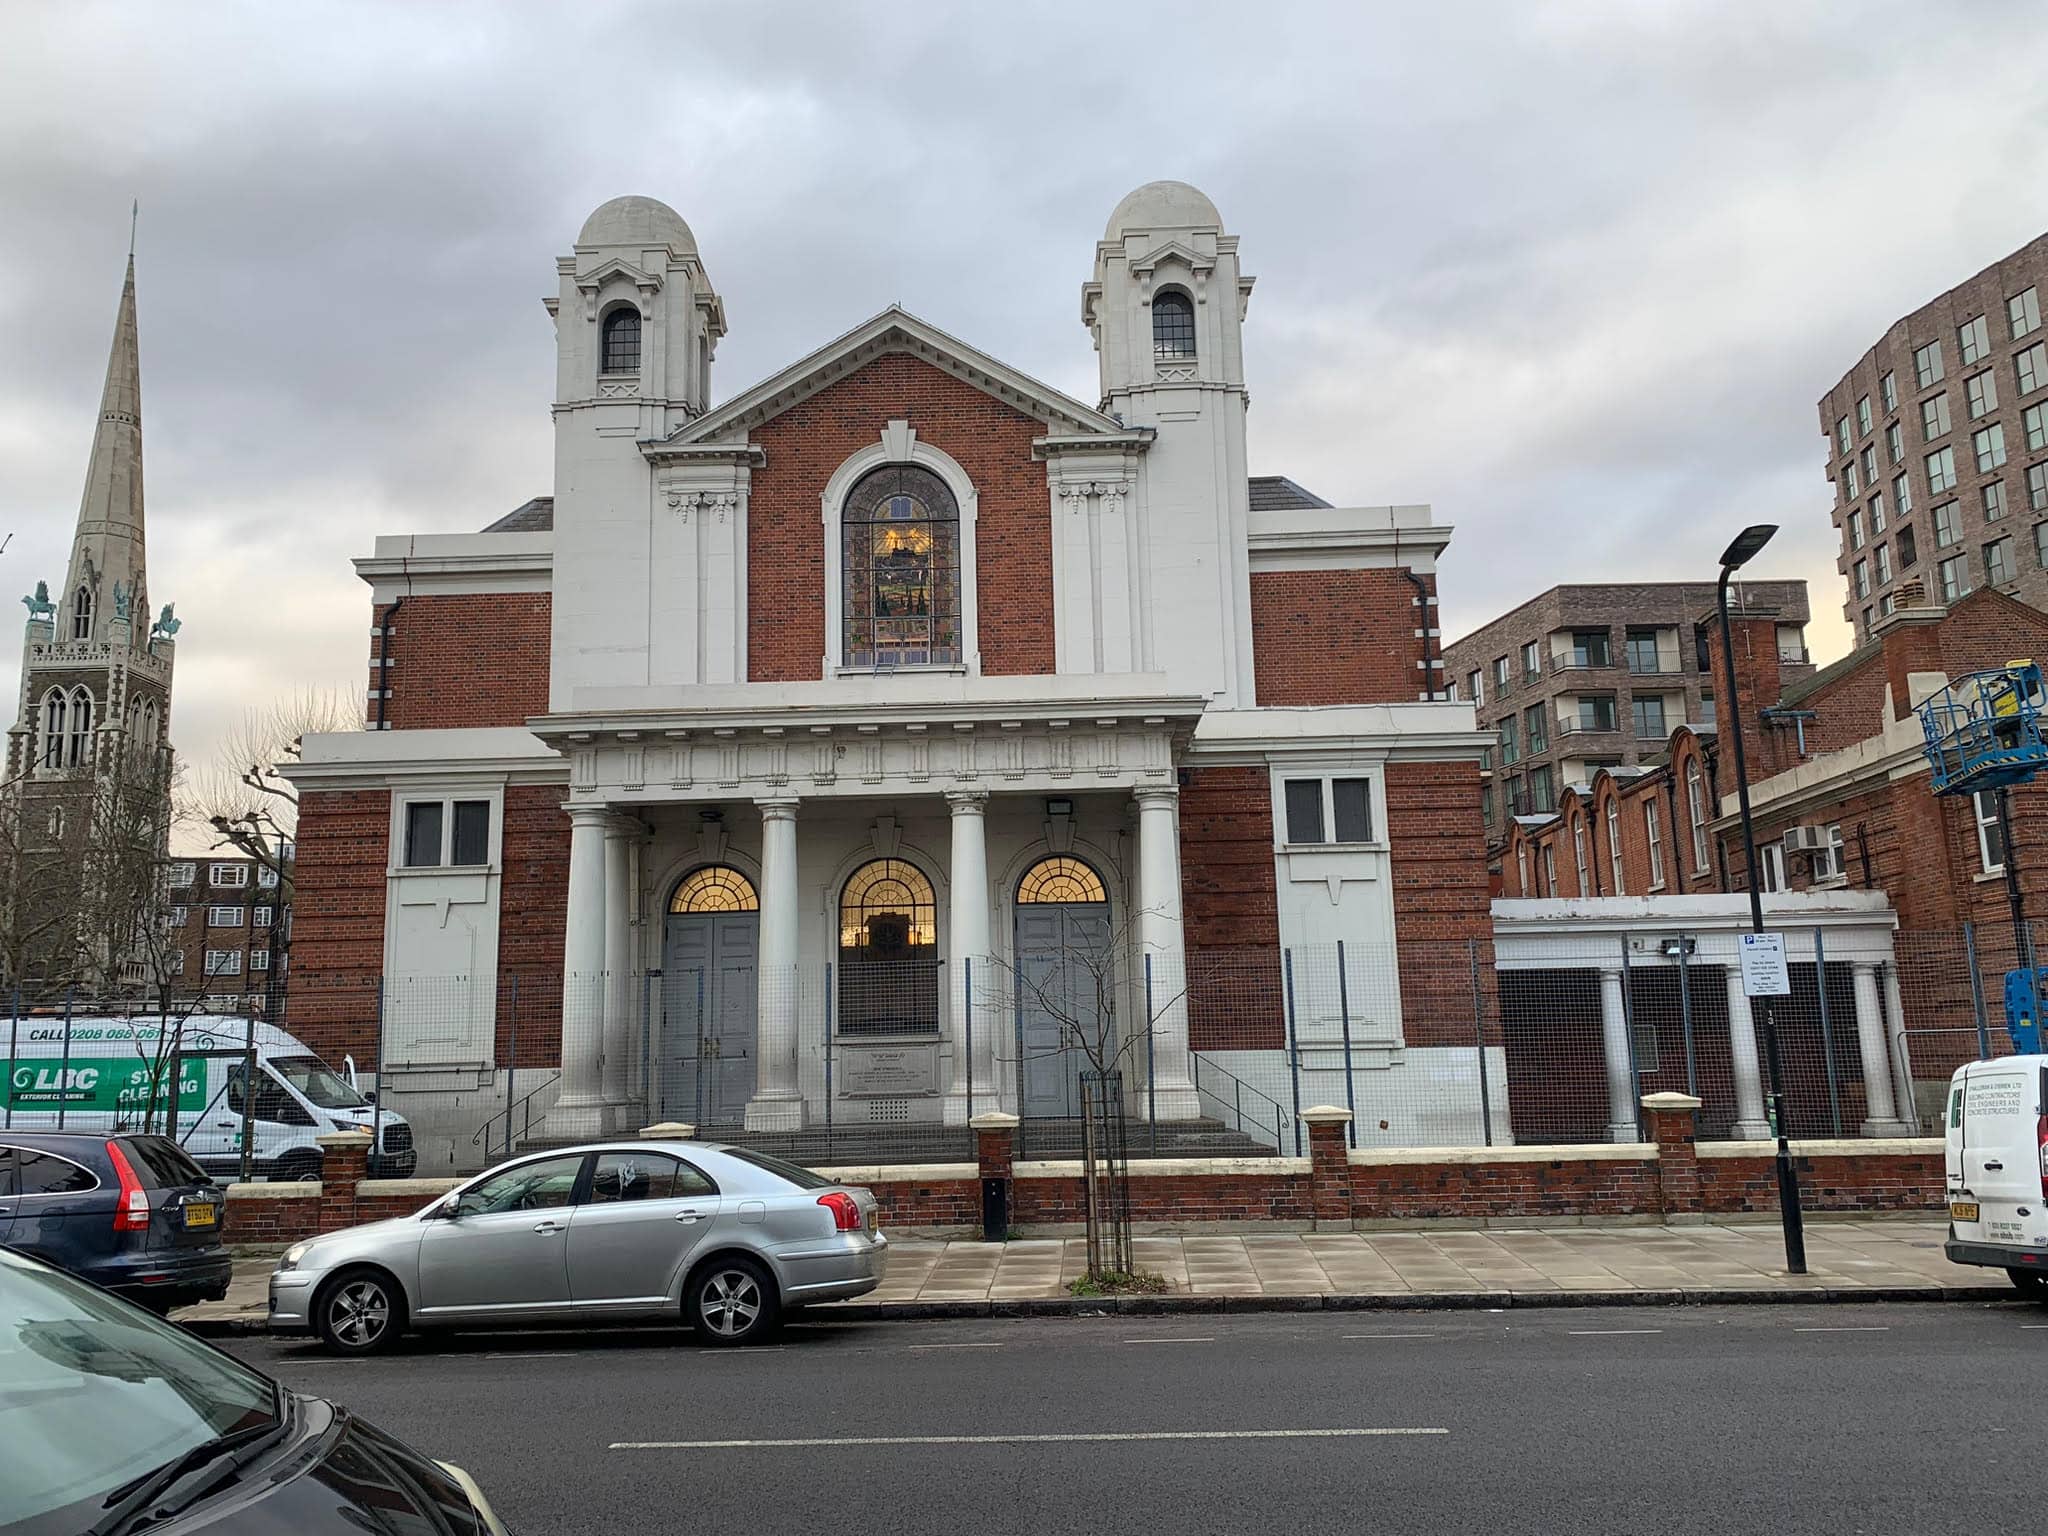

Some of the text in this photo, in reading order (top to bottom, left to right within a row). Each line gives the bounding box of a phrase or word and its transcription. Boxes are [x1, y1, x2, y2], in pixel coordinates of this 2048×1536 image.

[30, 1029, 64, 1041] CALL
[68, 1028, 104, 1040] 0208
[34, 1067, 99, 1090] LBC
[130, 1064, 188, 1085] STAM
[119, 1080, 199, 1102] CLENNG
